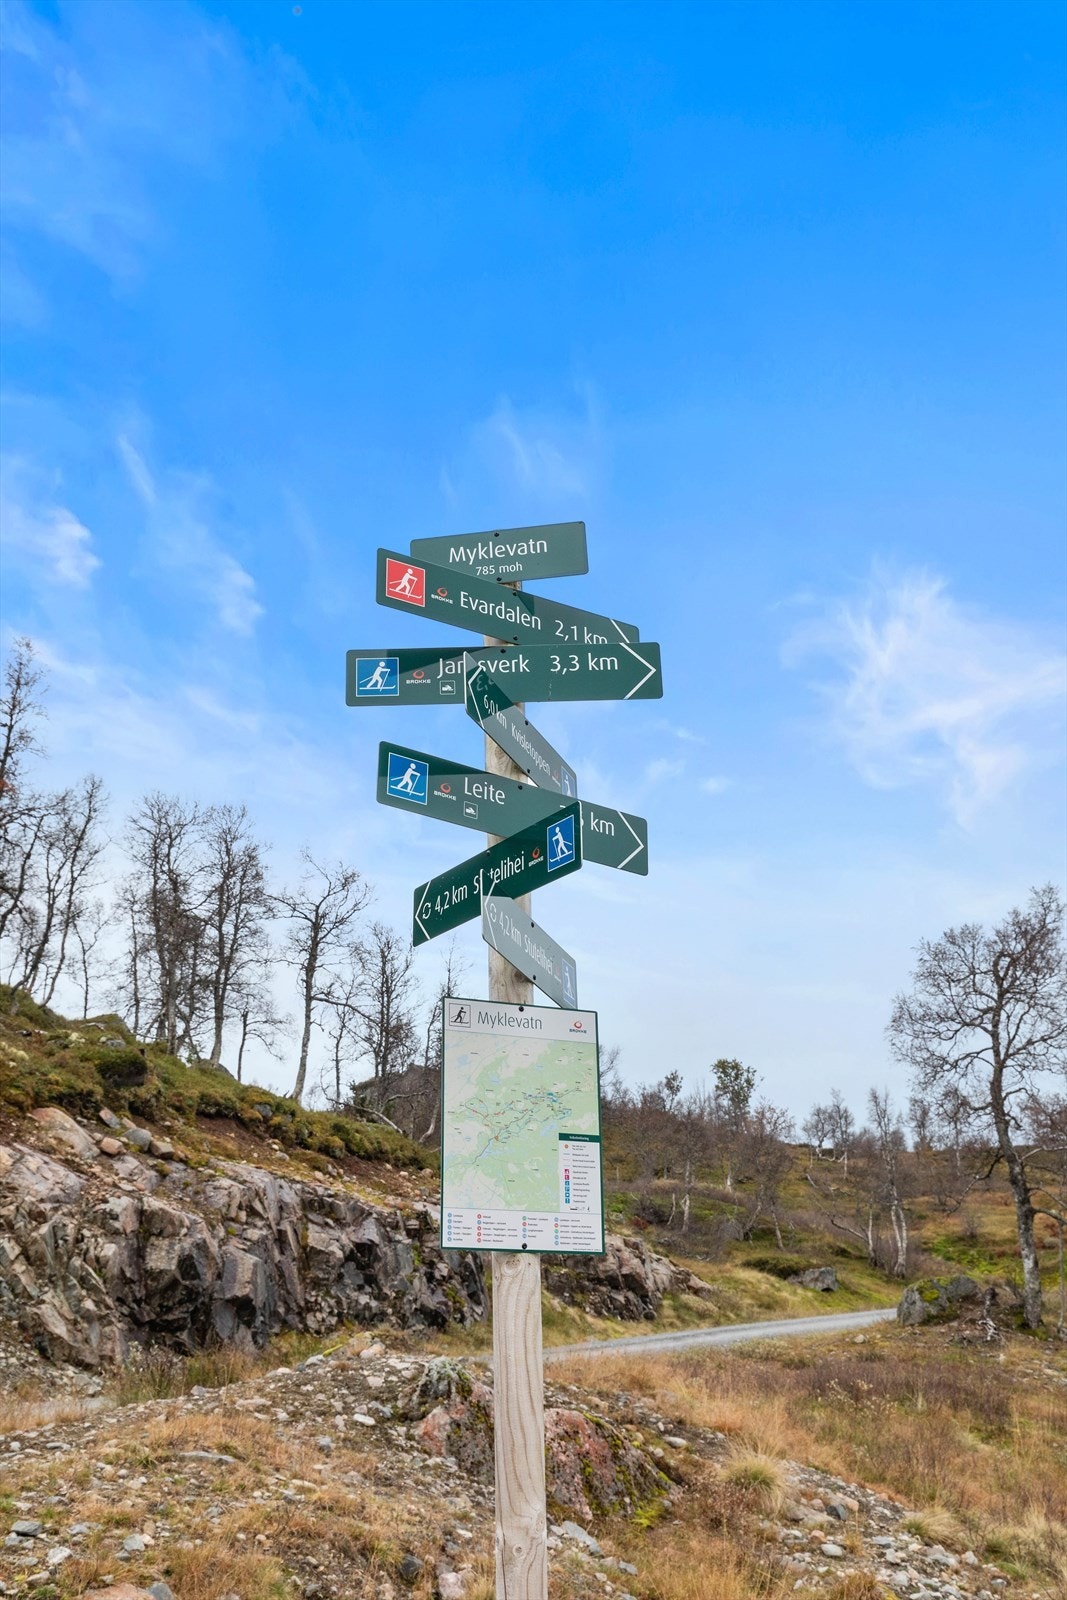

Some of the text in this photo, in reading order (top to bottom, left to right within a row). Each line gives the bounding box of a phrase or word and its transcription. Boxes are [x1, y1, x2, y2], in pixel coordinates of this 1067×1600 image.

[449, 538, 548, 565] Myklevatn
[475, 561, 523, 576] 785 moh
[431, 593, 454, 605] BROKKE
[460, 590, 608, 645] Evardalen 2,1 km
[549, 654, 580, 675] 3,3
[587, 652, 619, 671] km
[483, 694, 495, 716] 6,0
[496, 703, 507, 730] km
[433, 790, 457, 801] BROKKE
[464, 776, 506, 805] Leite
[590, 811, 615, 837] km
[434, 891, 450, 915] 4,2
[452, 885, 468, 905] km
[499, 911, 510, 936] 4,2
[510, 918, 522, 947] km
[477, 1010, 543, 1030] Myklevatn
